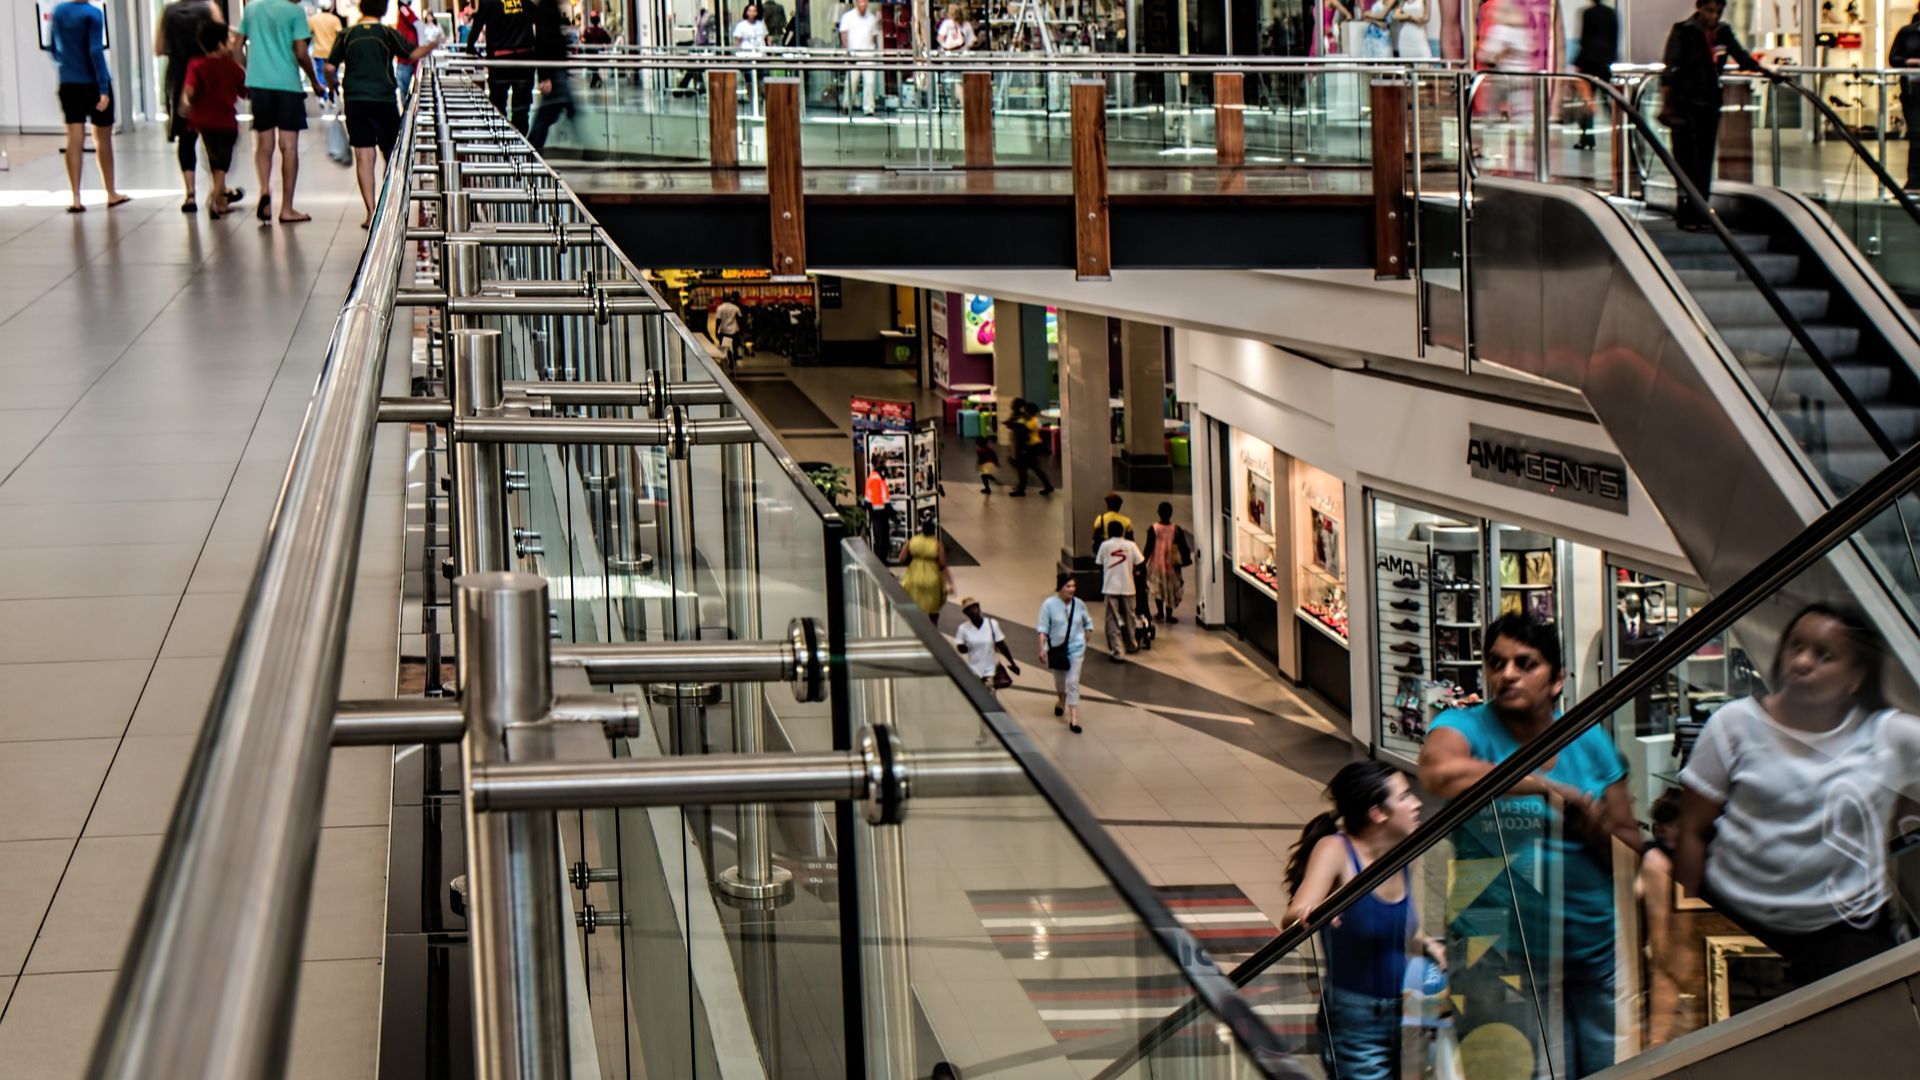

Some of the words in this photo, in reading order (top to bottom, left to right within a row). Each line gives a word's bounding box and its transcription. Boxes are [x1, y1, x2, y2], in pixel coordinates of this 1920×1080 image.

[1467, 438, 1521, 477] AMA
[1524, 453, 1620, 499] GENTS
[1377, 552, 1415, 578] AMA
